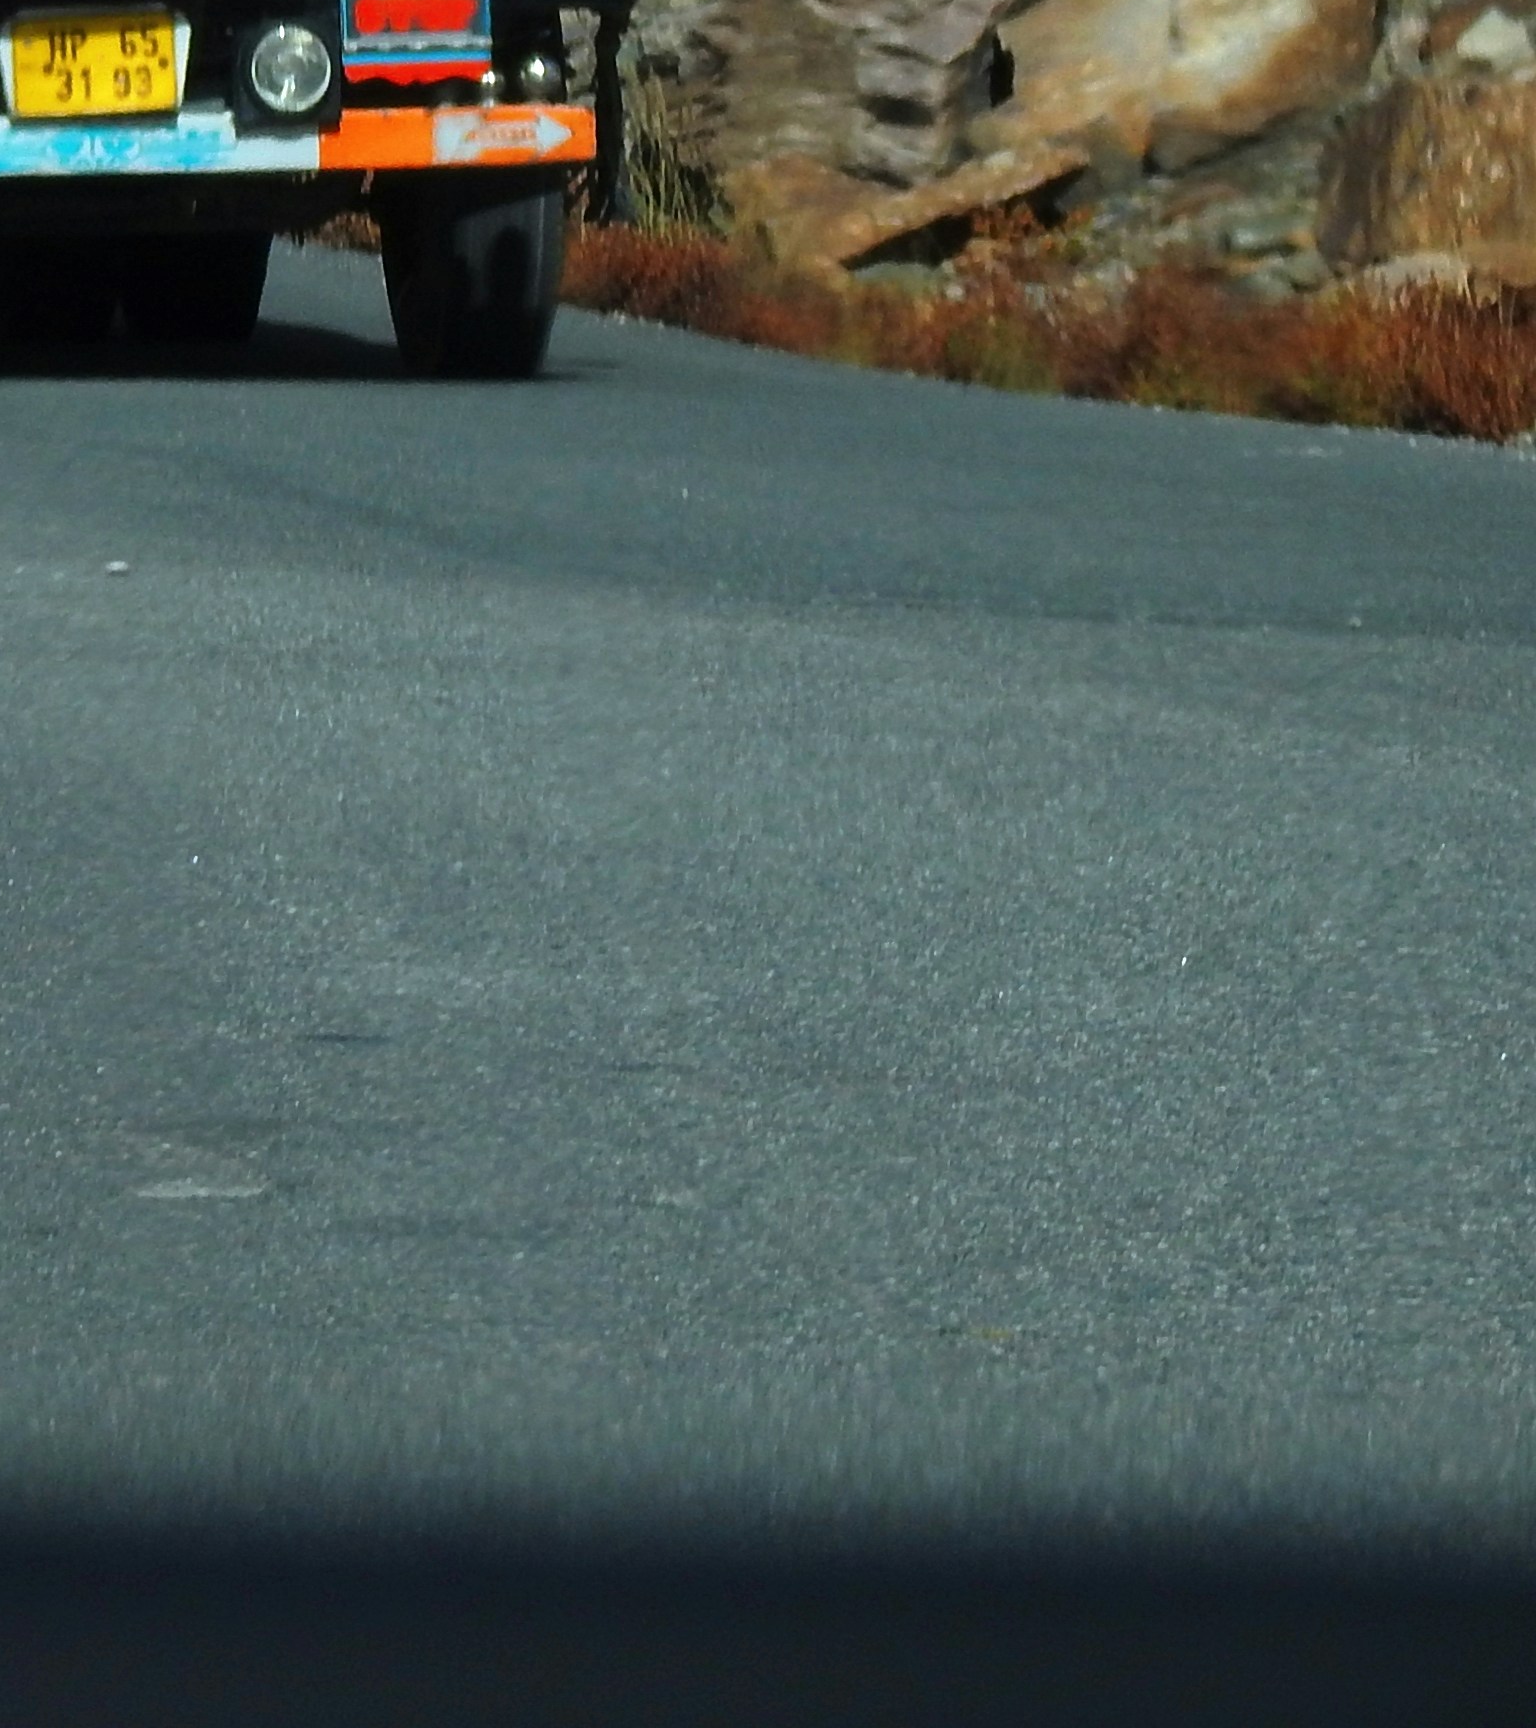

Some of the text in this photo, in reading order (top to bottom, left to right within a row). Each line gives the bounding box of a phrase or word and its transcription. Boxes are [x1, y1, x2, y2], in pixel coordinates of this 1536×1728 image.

[48, 26, 158, 62] HP 65
[56, 67, 92, 102] 31
